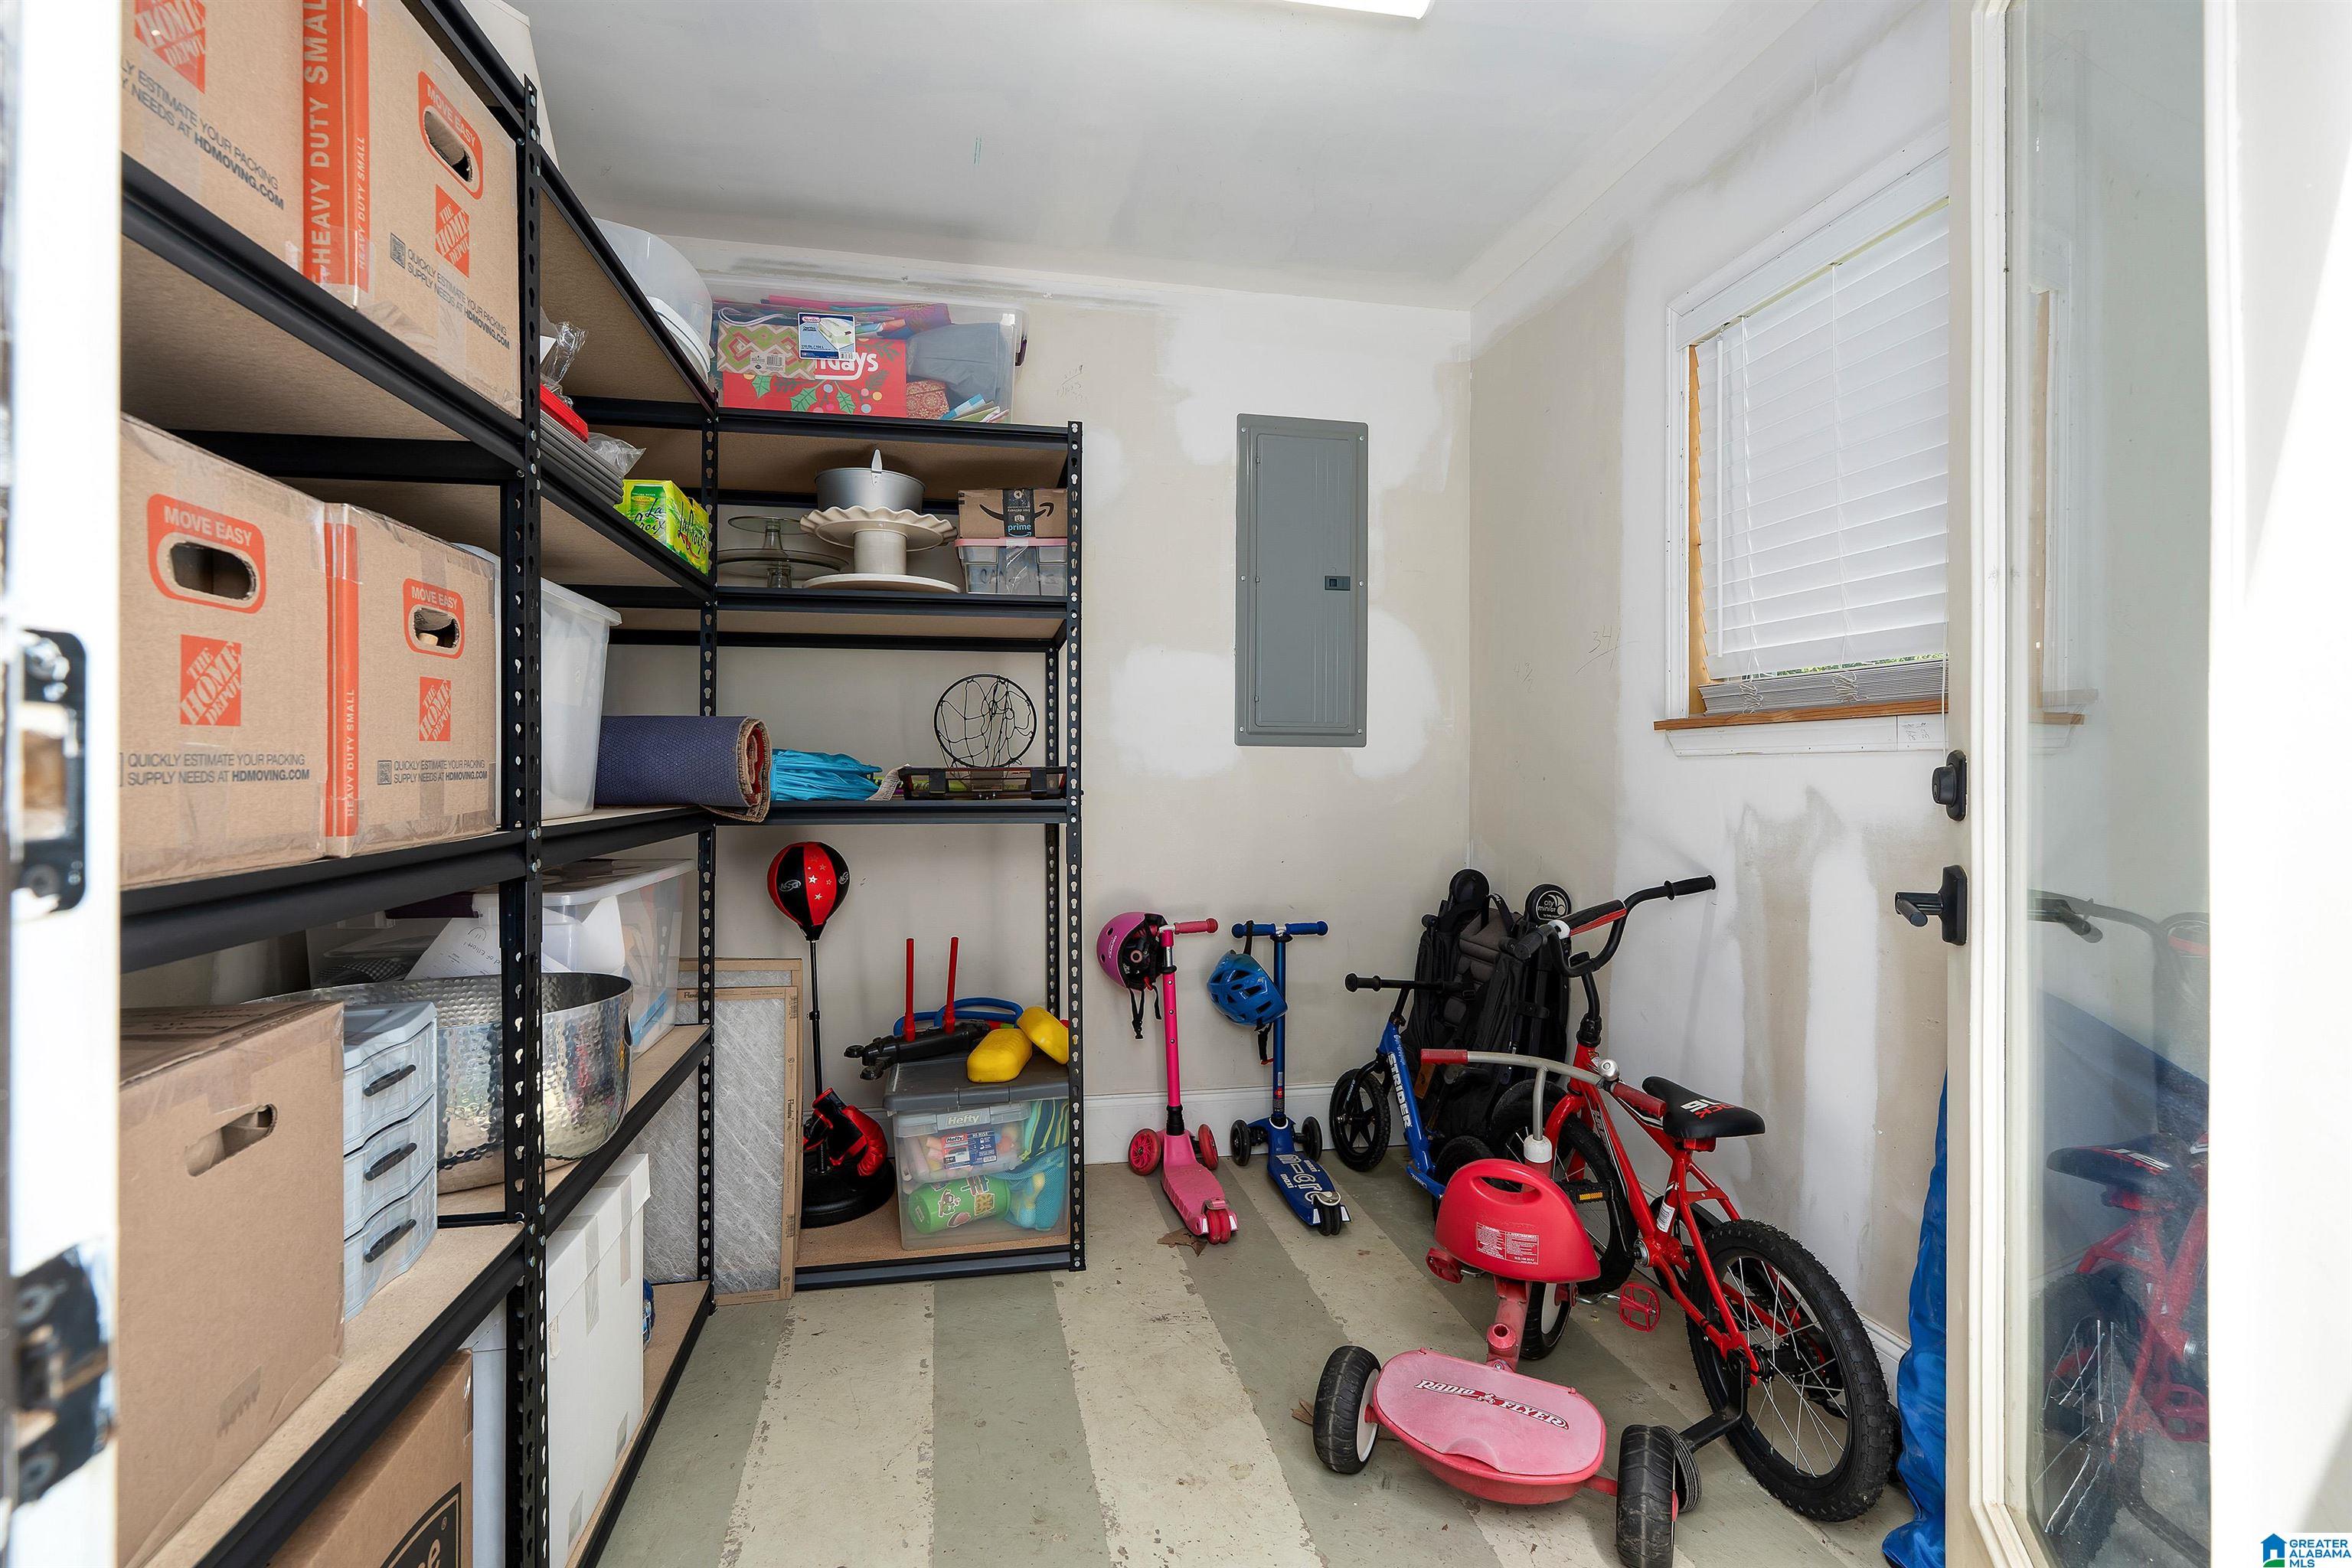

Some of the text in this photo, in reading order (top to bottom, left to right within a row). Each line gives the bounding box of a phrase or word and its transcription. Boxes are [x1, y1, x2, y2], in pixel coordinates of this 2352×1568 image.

[138, 69, 279, 191] ESTIMATE YOUR PACKING
[304, 0, 331, 264] HEAVY DUTY SMAL
[427, 83, 475, 146] MOVE EASY
[132, 83, 283, 210] NEEDS AT HDMOVING.COM
[357, 137, 365, 181] SMALL
[436, 210, 469, 256] HOME
[407, 262, 433, 288] SUPPLY
[434, 284, 455, 306] NEEDS
[464, 309, 510, 350] HDMOVING.COM
[408, 249, 507, 336] QUICKLY ESTIMATE YOUR PACKING
[164, 505, 252, 546] MOVE EASY
[645, 498, 662, 519] La
[1008, 524, 1031, 532] prime
[412, 586, 457, 609] MOVE EASY
[187, 647, 214, 680] THE
[181, 642, 240, 724] HOME
[204, 673, 241, 725] DEPOT
[423, 685, 436, 708] THE
[420, 679, 451, 741] HOME
[432, 702, 451, 741] DEPOT
[128, 753, 305, 767] QUICKLY ESTIMATE YOUR PACKING
[128, 769, 309, 786] SUPPLY NEEDS AT HDMOVING.COM
[394, 760, 485, 770] QUICKLY ESTIMATE YOUR PACKING
[394, 771, 487, 783] SUPPLY NEEDS AT HDMOVING.COM
[1387, 1052, 1413, 1129] STRIDER
[948, 1114, 979, 1126] Hefty
[946, 1135, 964, 1143] Hefty
[1280, 1174, 1297, 1188] maxi
[1415, 1380, 1475, 1395] RADIO
[1499, 1400, 1568, 1429] FLYER
